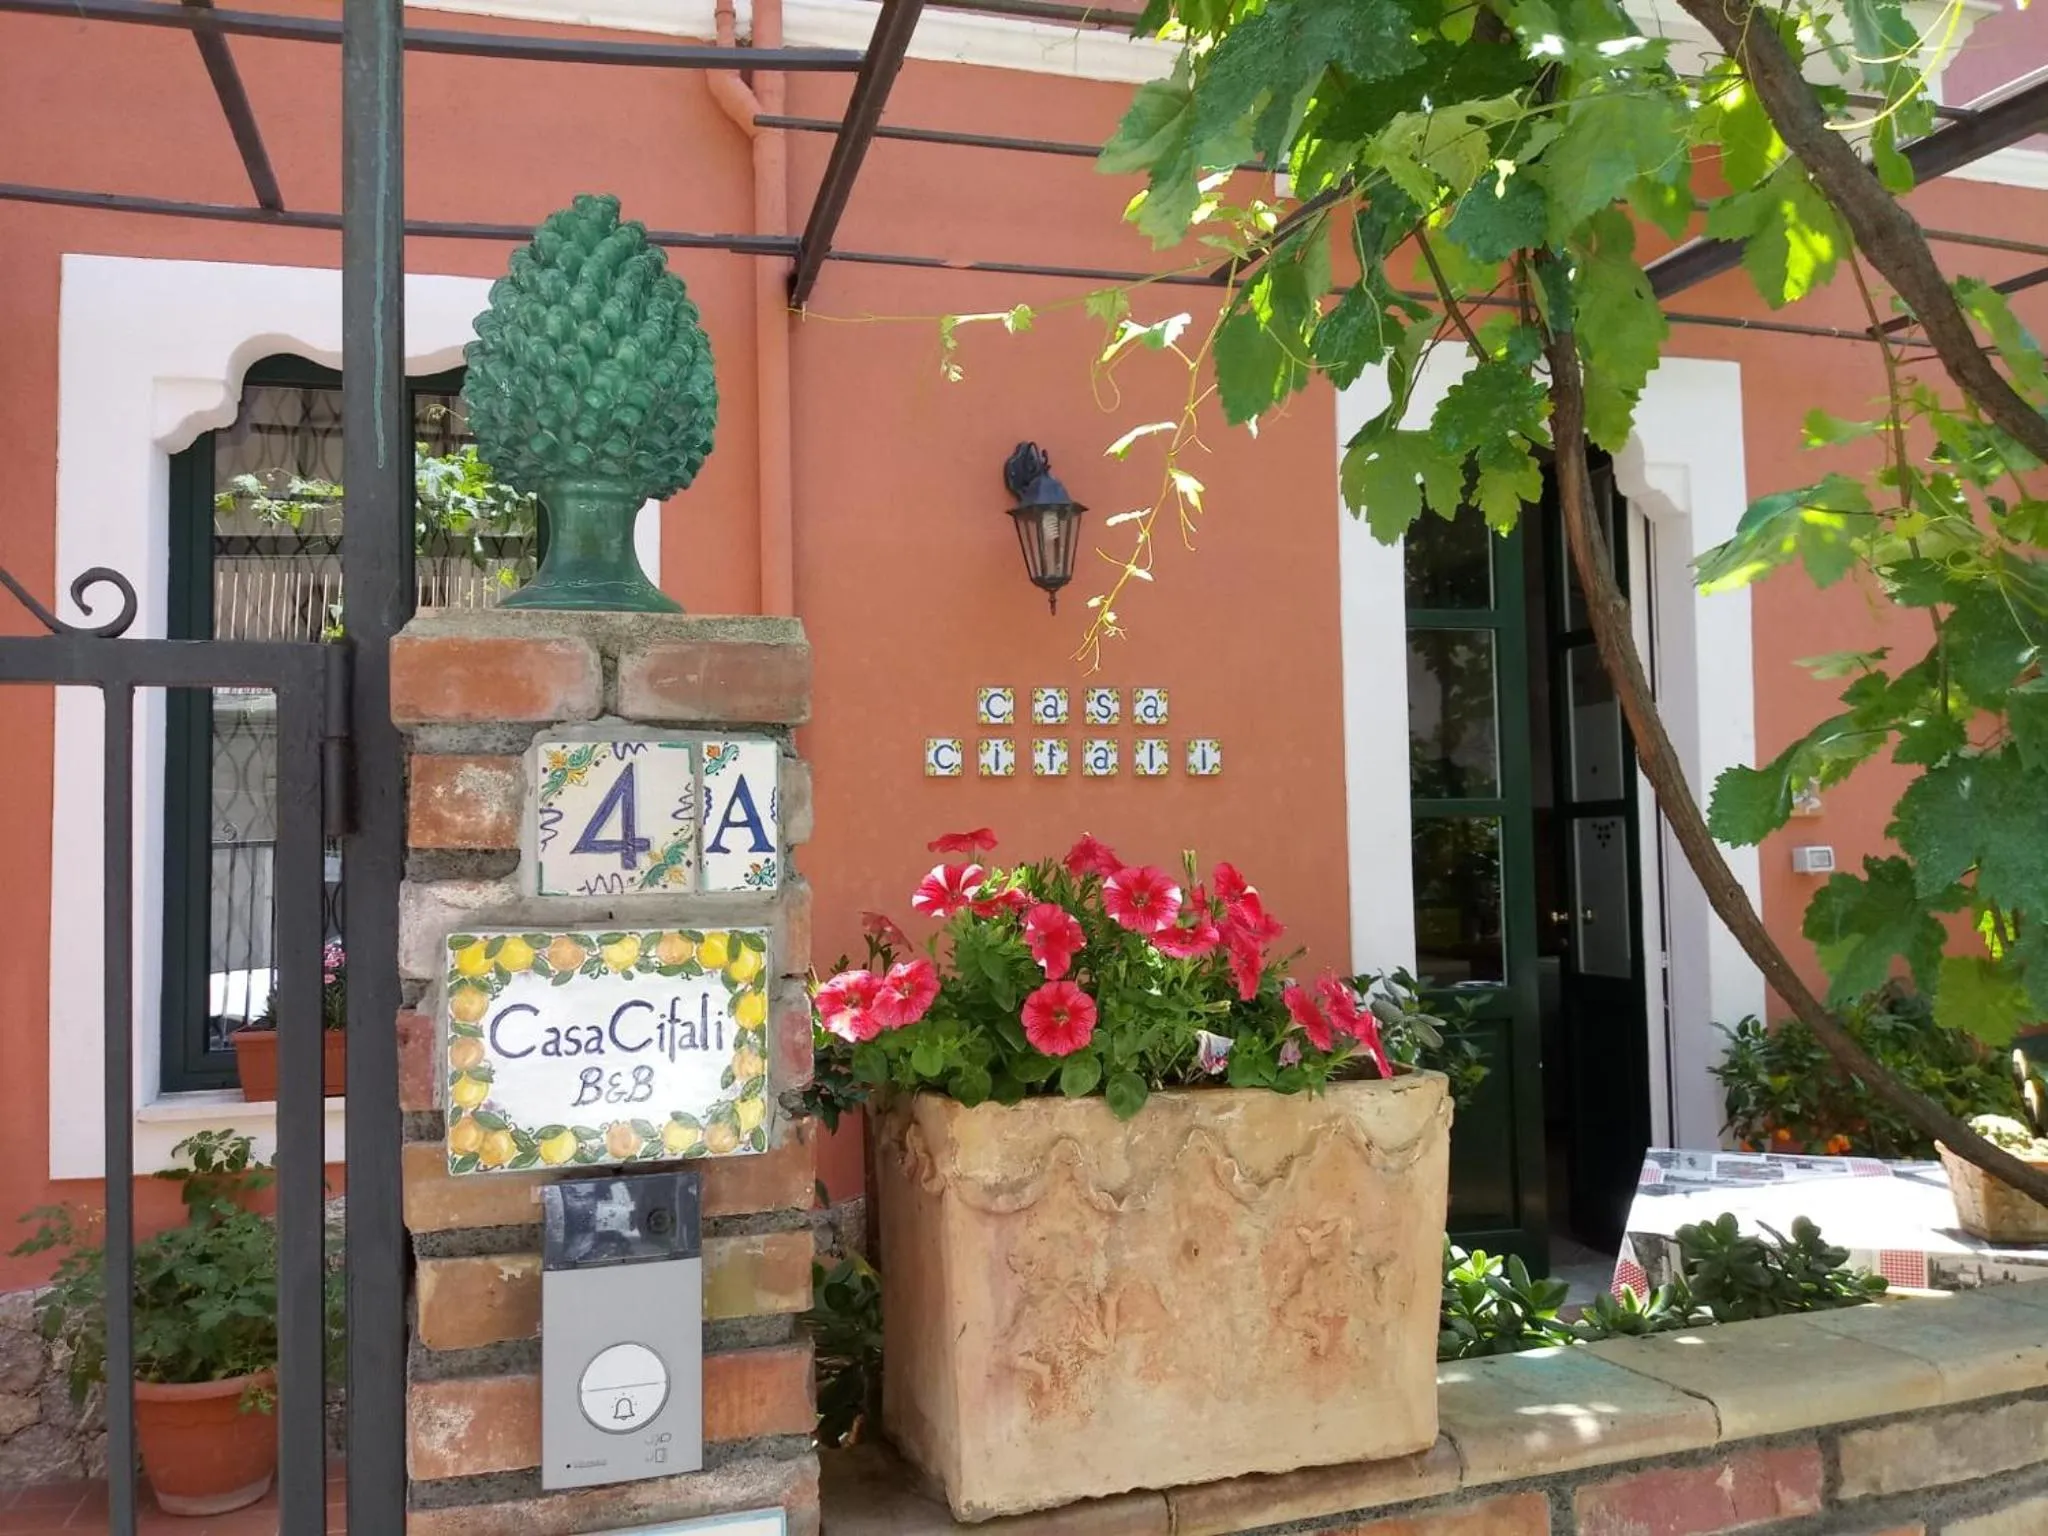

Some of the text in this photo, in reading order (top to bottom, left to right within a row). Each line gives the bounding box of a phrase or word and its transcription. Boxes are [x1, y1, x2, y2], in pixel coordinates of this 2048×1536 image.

[569, 761, 777, 870] 4 A
[570, 1064, 655, 1107] B&B
